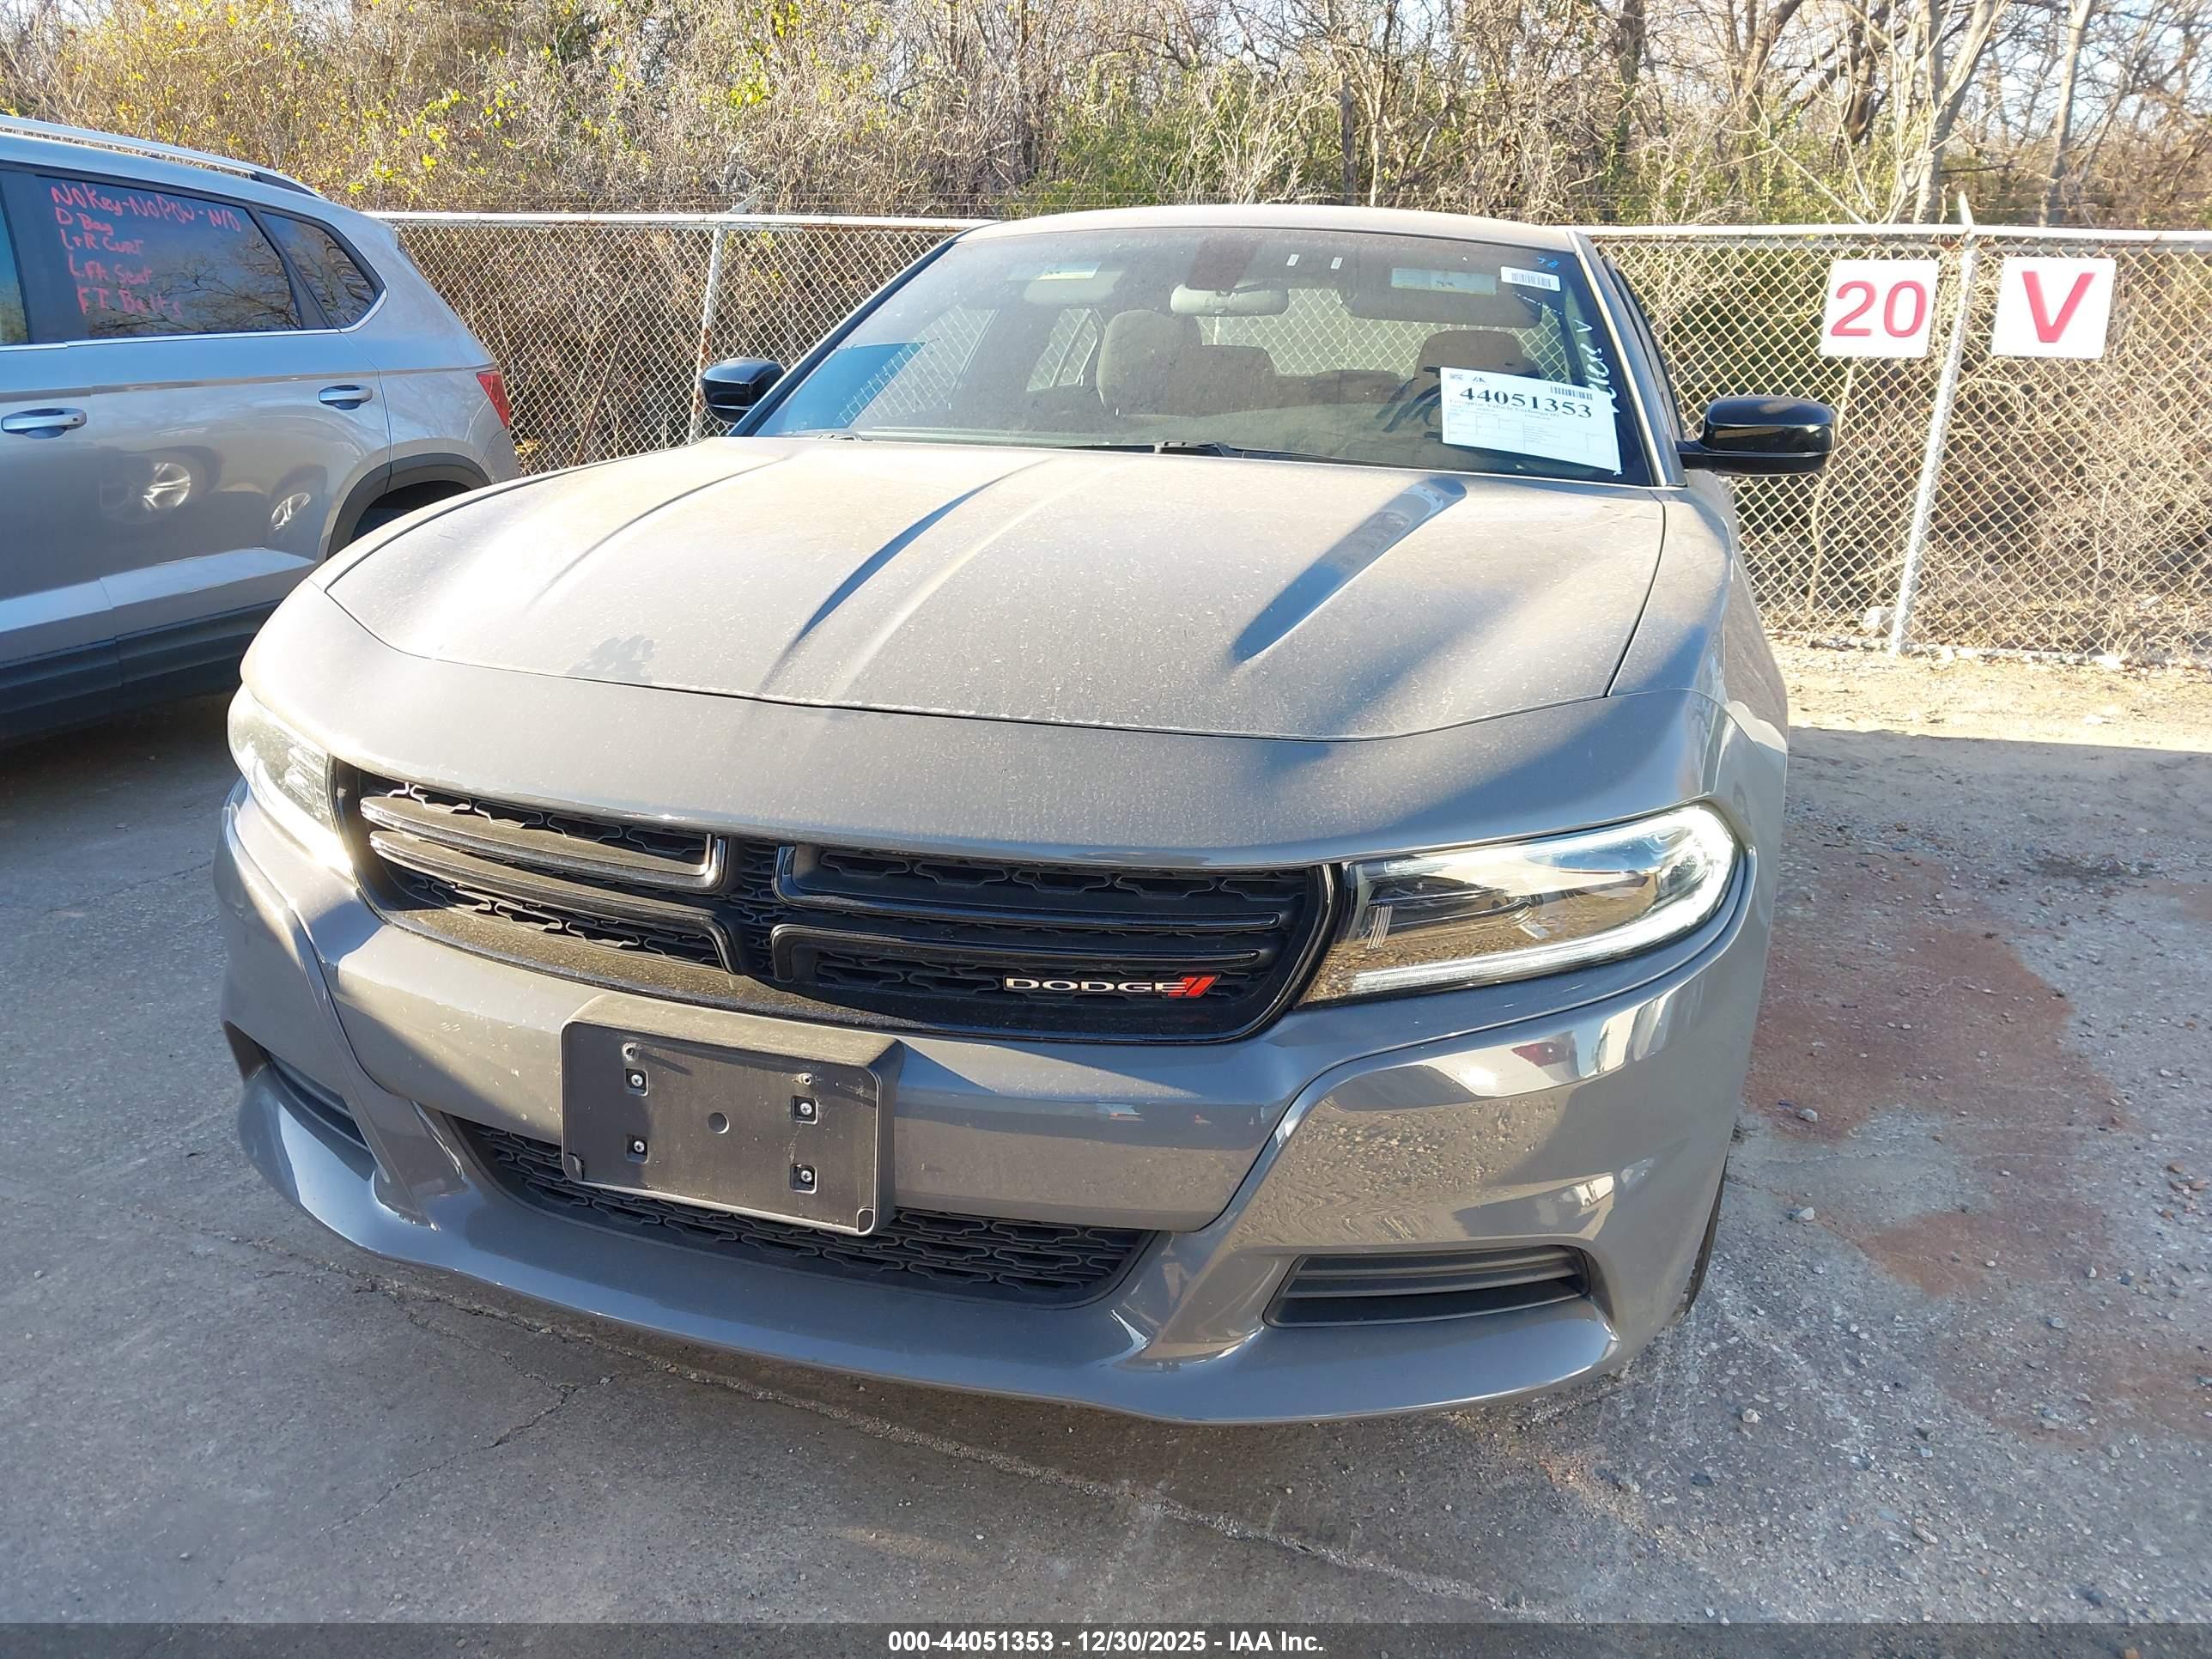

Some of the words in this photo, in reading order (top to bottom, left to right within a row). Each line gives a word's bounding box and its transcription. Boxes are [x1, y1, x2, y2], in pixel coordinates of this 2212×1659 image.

[1830, 280, 1927, 338] 20
[2021, 270, 2096, 343] V
[1459, 386, 1592, 418] 44051353
[1006, 977, 1188, 993] DODGE
